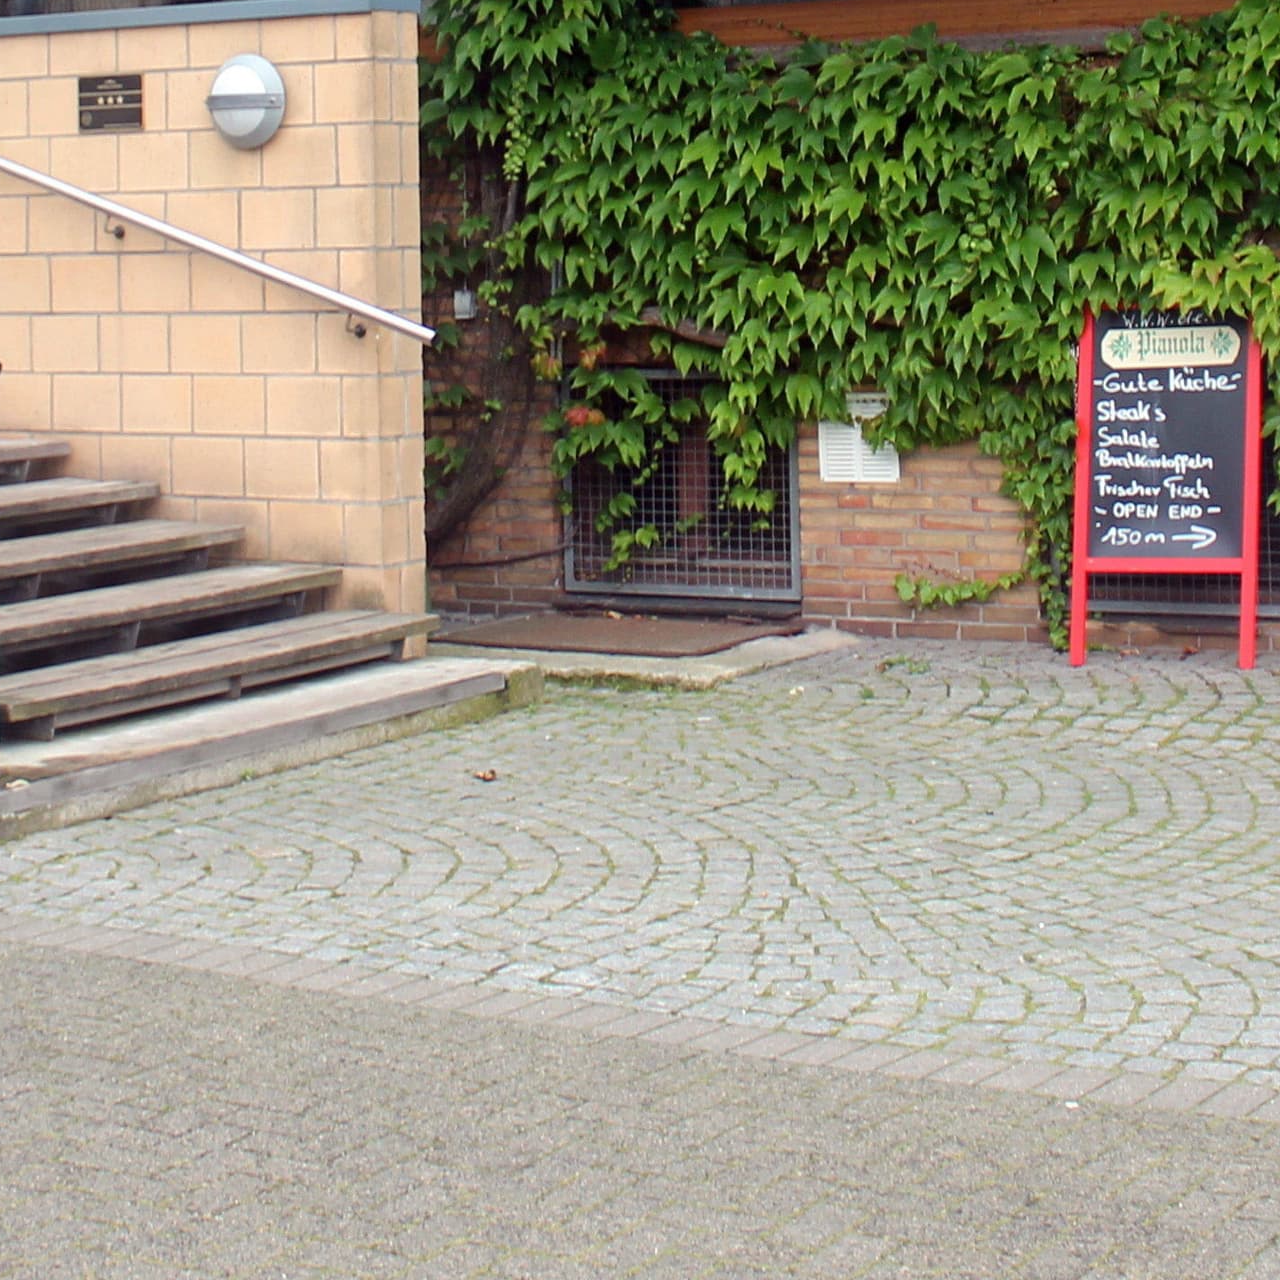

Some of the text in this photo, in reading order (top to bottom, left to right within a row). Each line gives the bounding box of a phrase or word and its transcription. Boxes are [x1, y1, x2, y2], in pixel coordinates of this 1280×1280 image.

[1136, 330, 1206, 360] Pianola
[1097, 426, 1160, 449] Salate
[1113, 502, 1203, 520] OPEN END
